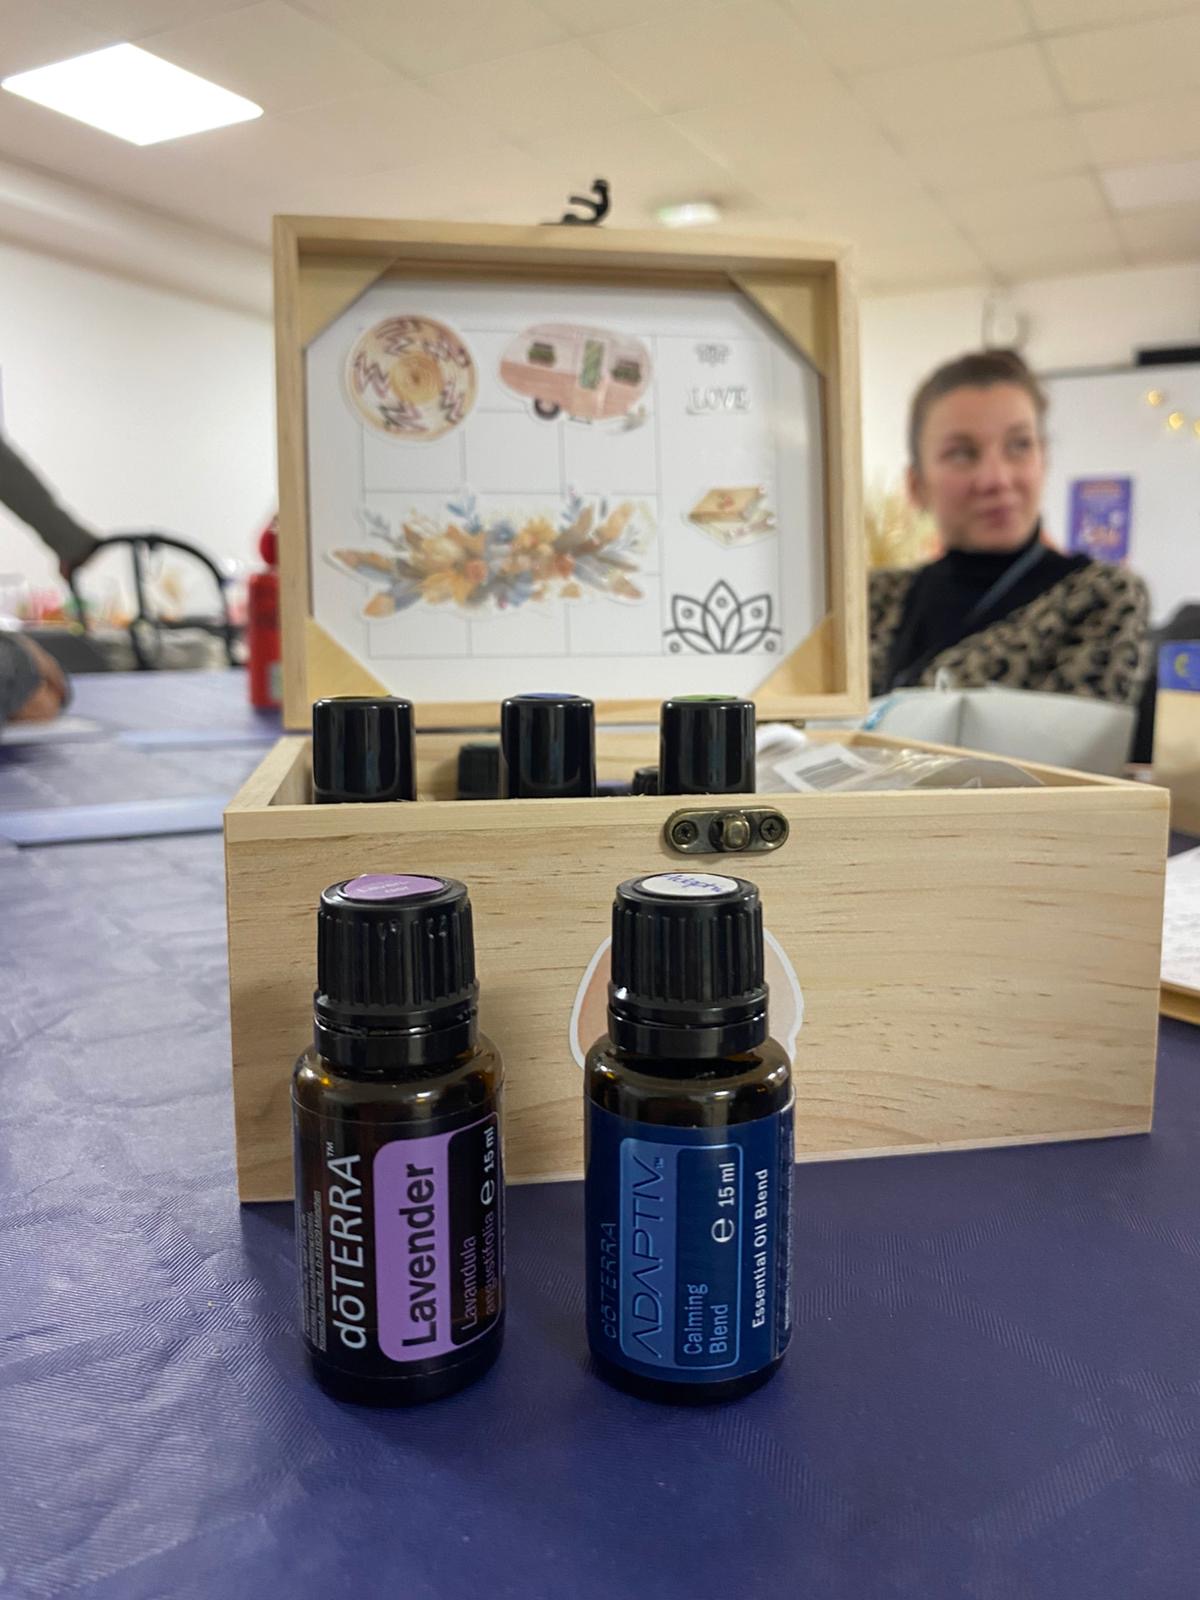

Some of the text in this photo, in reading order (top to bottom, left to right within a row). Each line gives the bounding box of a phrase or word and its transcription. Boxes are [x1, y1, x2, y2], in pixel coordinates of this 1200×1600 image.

[483, 1126, 495, 1147] ml
[483, 1149, 495, 1173] 15
[718, 1162, 736, 1183] ml
[718, 1185, 735, 1207] 15
[399, 1163, 437, 1348] Lavender
[482, 1210, 496, 1316] angustifolia
[752, 1169, 769, 1329] Essential Oil Blend
[460, 1235, 478, 1331] Lavandula
[683, 1283, 708, 1355] Calming
[709, 1303, 729, 1354] Blend
